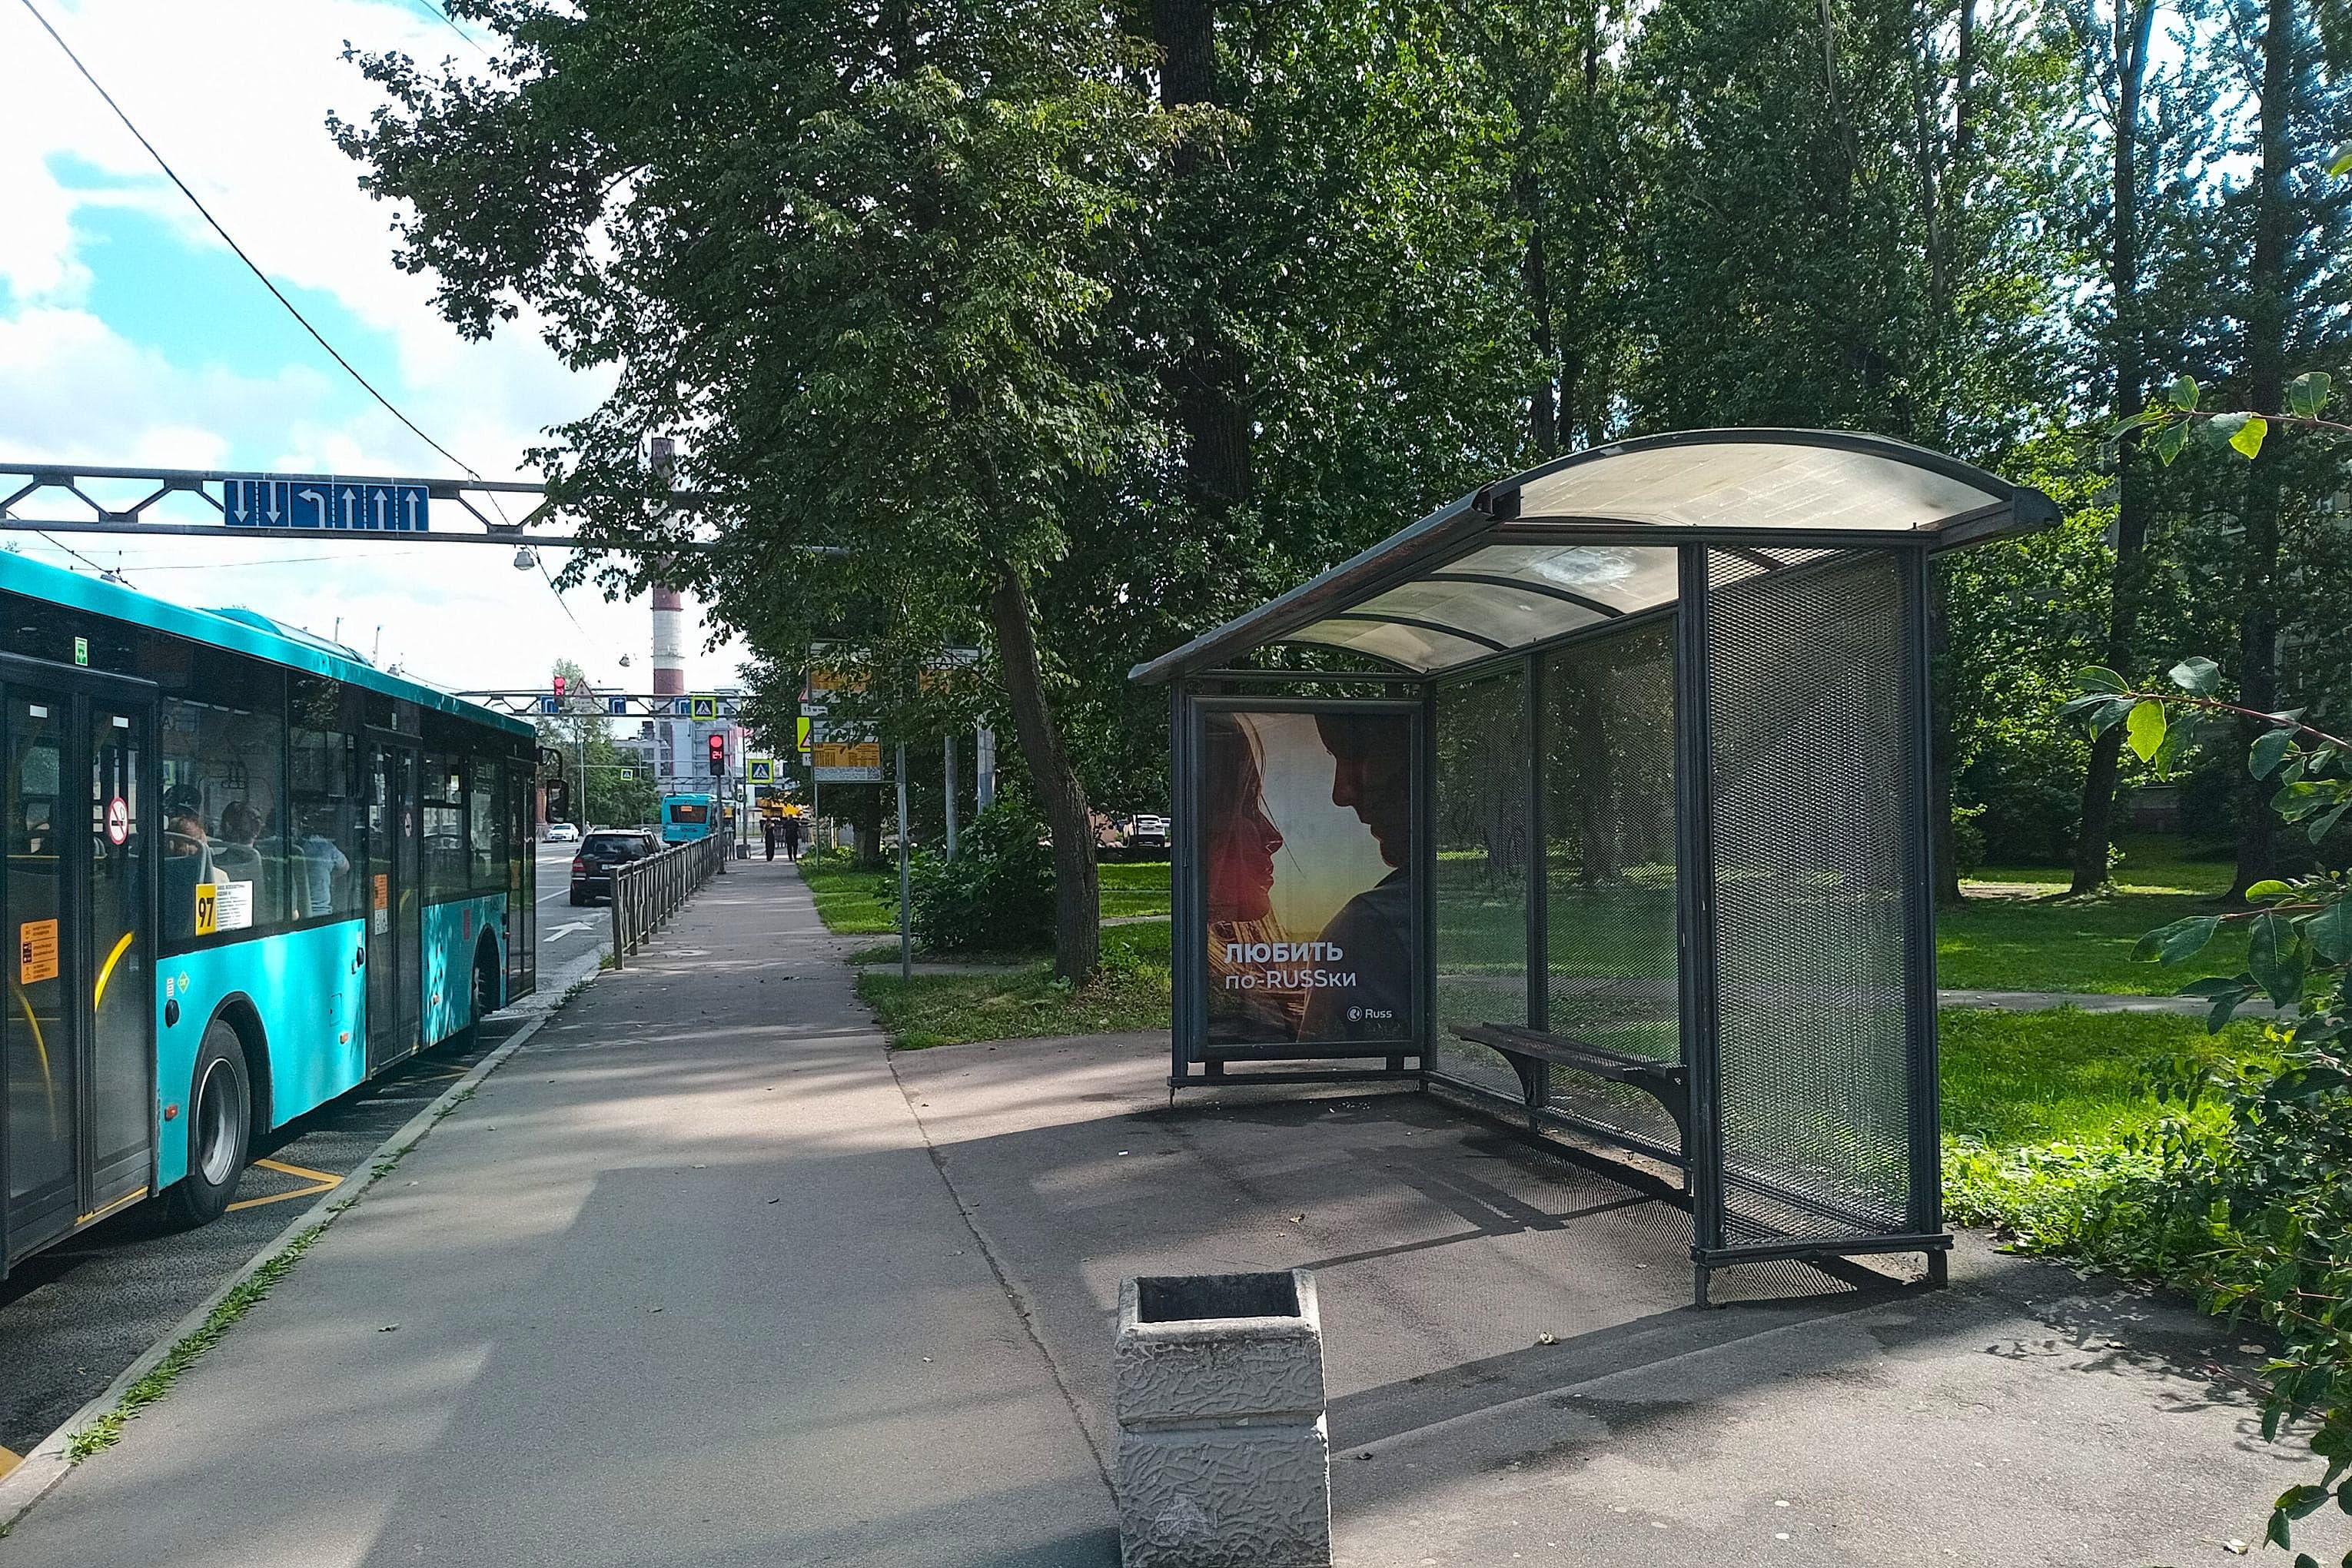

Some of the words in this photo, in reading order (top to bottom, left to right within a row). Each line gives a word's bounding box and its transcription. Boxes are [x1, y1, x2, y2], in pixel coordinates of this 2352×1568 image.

[712, 750, 723, 759] 24
[198, 897, 215, 928] 97
[1225, 942, 1344, 963] ЛЮБИТЬ
[1225, 968, 1357, 989] по-RUSSки
[1365, 1008, 1393, 1018] Russ
